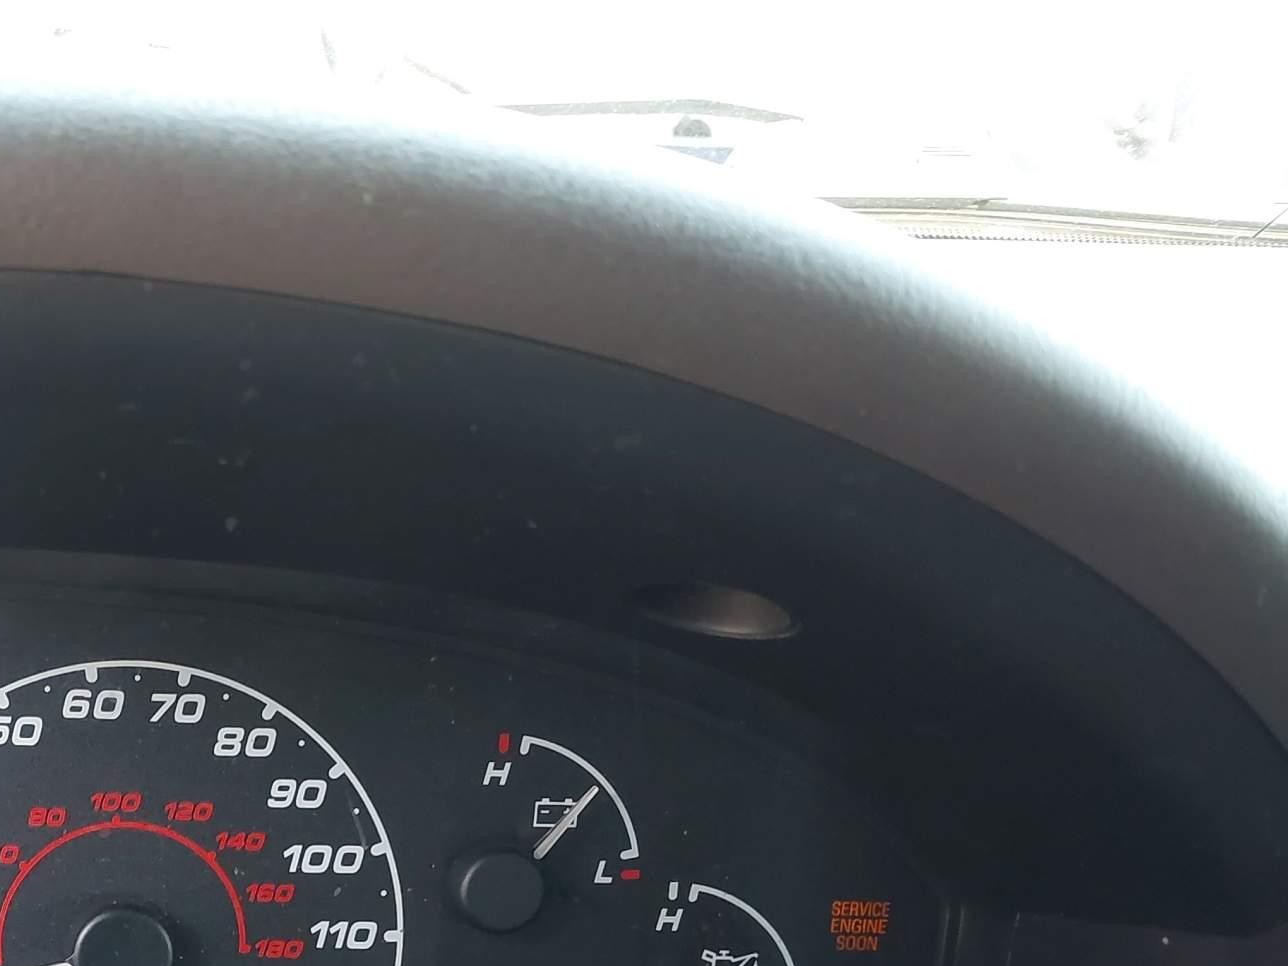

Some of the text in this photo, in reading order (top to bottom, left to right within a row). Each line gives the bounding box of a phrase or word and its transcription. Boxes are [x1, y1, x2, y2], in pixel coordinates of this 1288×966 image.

[62, 689, 125, 720] 60
[149, 693, 206, 724] 70
[213, 728, 277, 757] 80
[483, 761, 511, 785] H
[90, 793, 141, 811] 100
[266, 779, 328, 809] 90
[28, 808, 66, 826] 80
[164, 802, 213, 821] 120
[216, 832, 266, 851] 140
[282, 845, 364, 873] 100
[594, 861, 612, 883] L
[246, 884, 295, 903] 160
[831, 901, 890, 917] SERVICE
[656, 909, 684, 932] H
[830, 918, 888, 934] ENGINE
[310, 921, 378, 949] 110
[835, 935, 878, 951] SOON
[254, 940, 303, 958] 180
